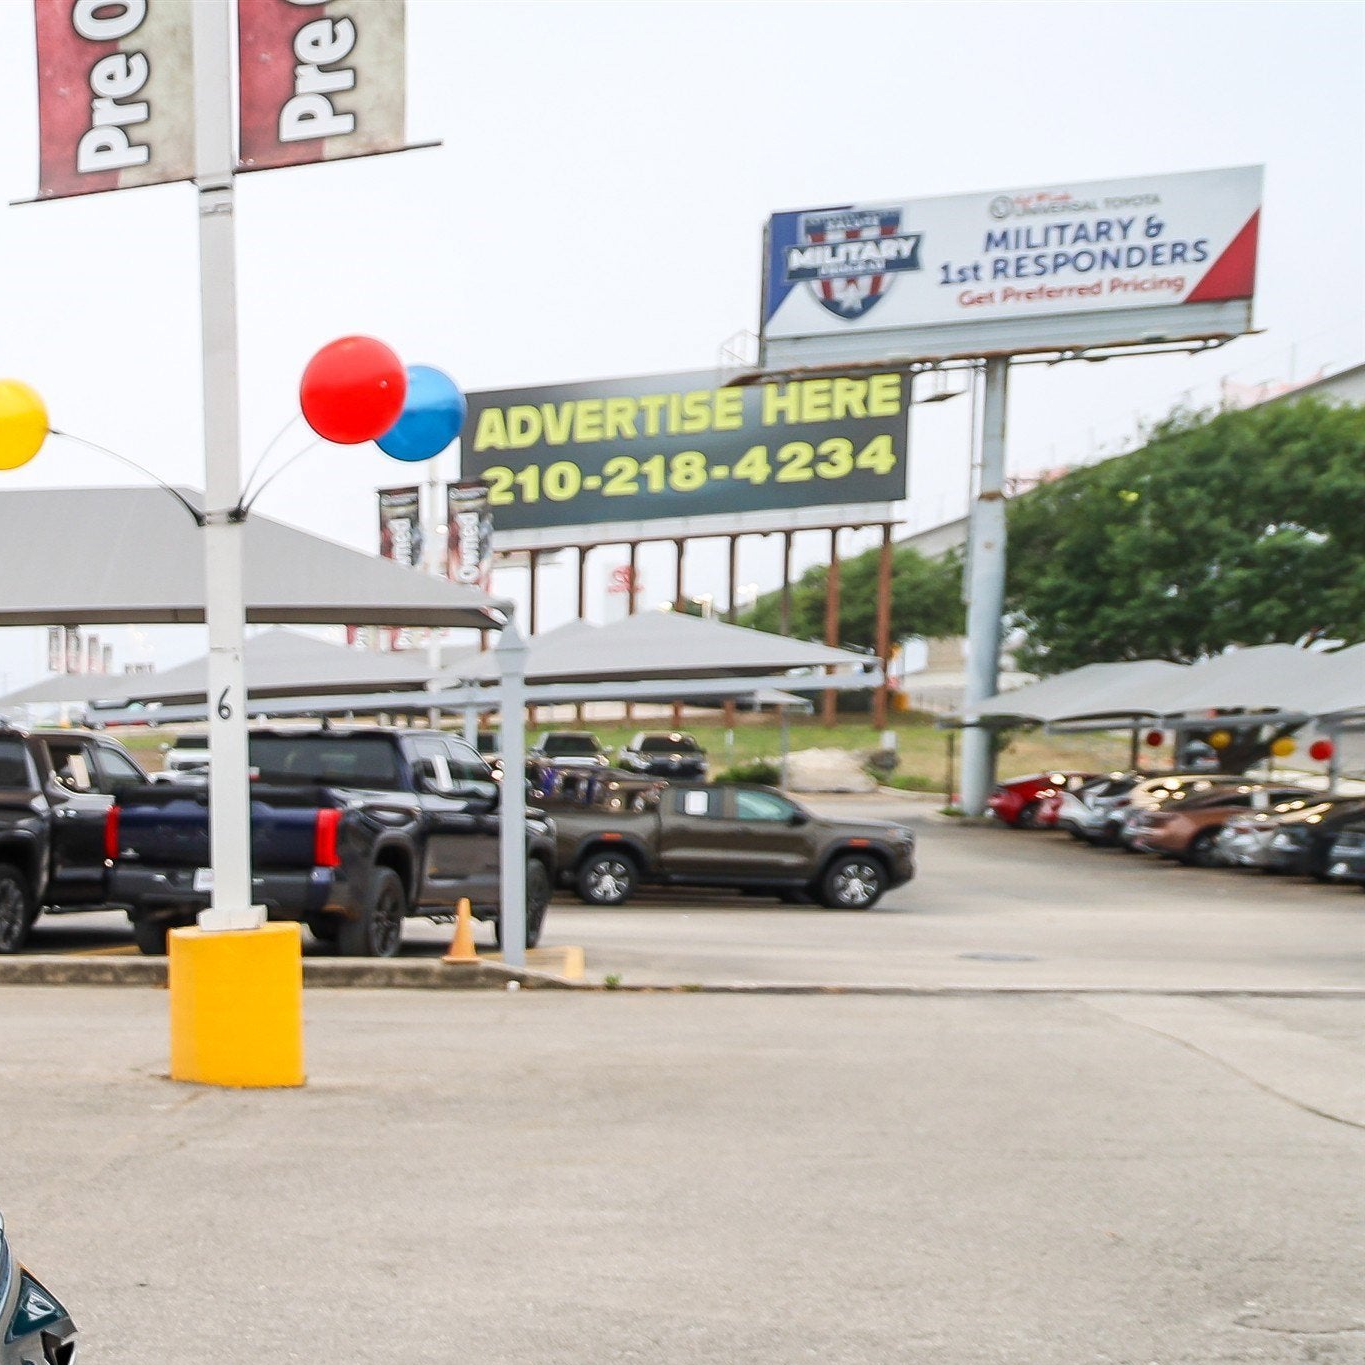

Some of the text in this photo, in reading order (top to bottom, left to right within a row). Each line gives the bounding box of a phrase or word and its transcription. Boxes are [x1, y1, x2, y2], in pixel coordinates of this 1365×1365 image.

[279, 16, 357, 142] Pre
[76, 51, 150, 173] Pre
[787, 236, 917, 271] MILITARY
[984, 214, 1165, 253] MILITARY &
[939, 239, 1210, 285] 1st RESPONDERS
[958, 275, 1186, 307] Get Preferred Pricing
[475, 373, 903, 451] ADVERTISE HERE
[218, 685, 231, 720] 6
